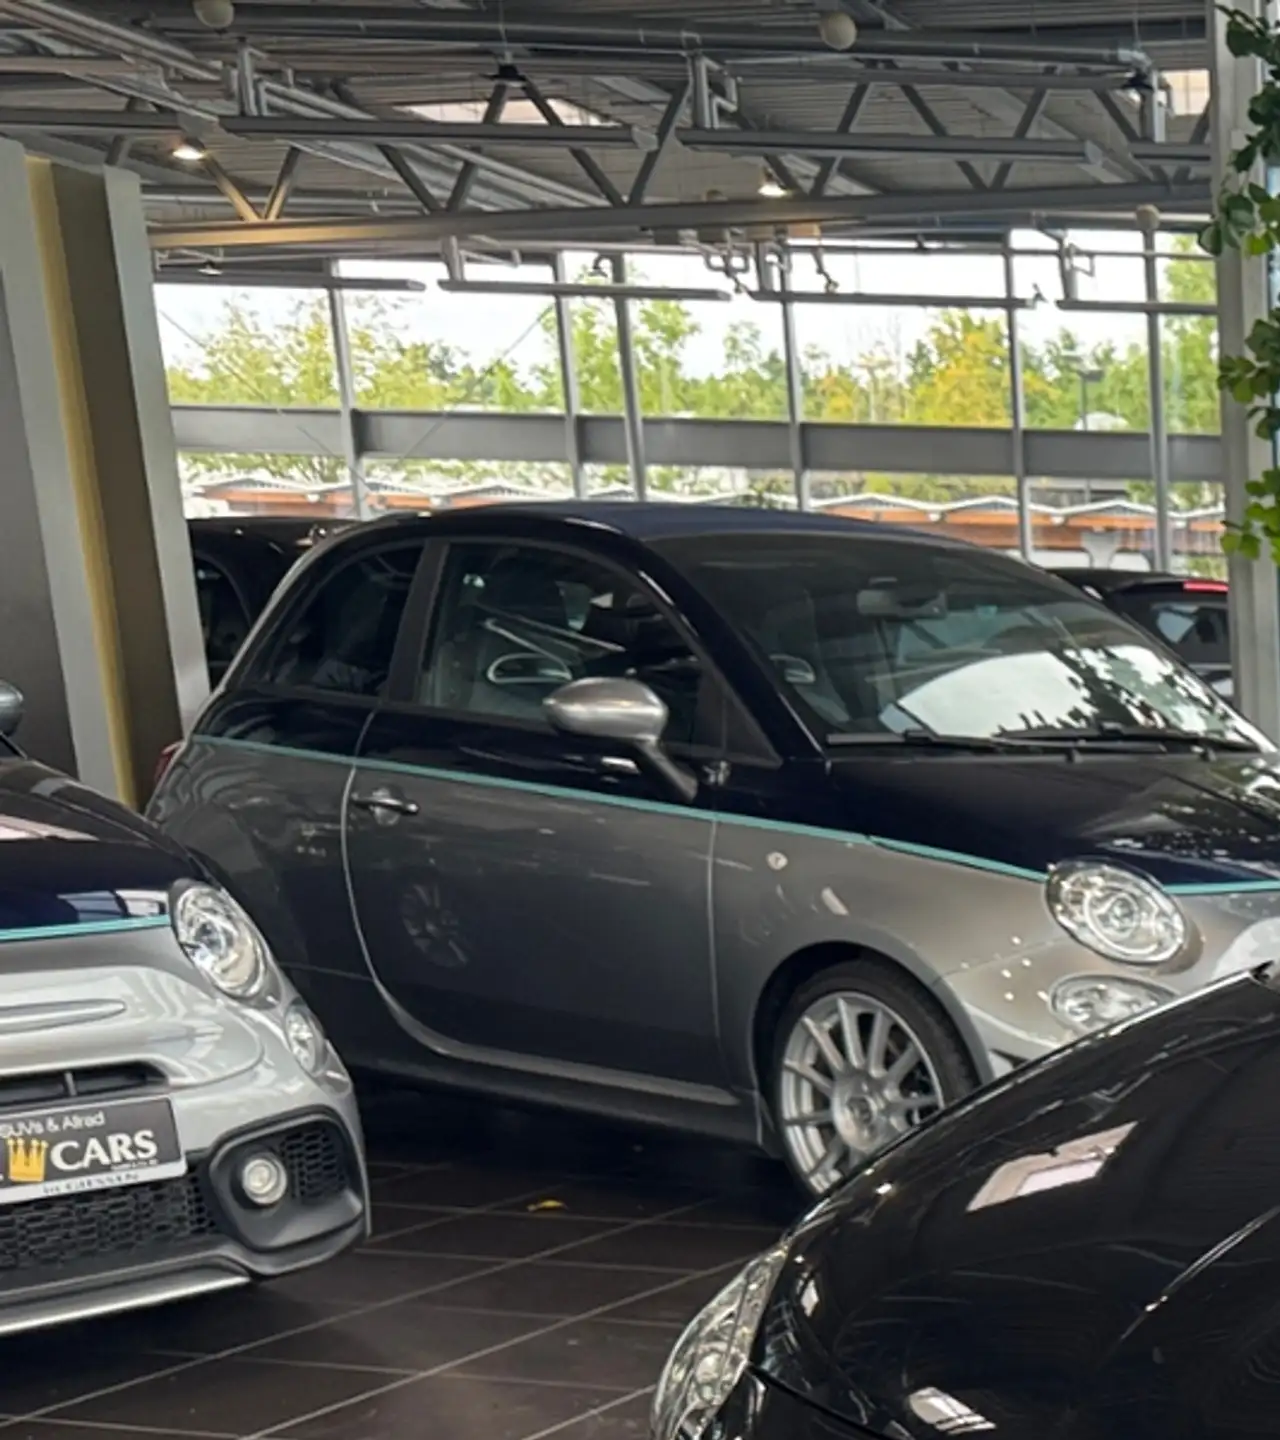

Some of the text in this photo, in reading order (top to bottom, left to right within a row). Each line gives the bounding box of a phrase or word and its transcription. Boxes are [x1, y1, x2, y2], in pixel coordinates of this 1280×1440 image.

[46, 1117, 60, 1132] &
[62, 1111, 106, 1131] Allrad
[50, 1129, 158, 1171] CARS
